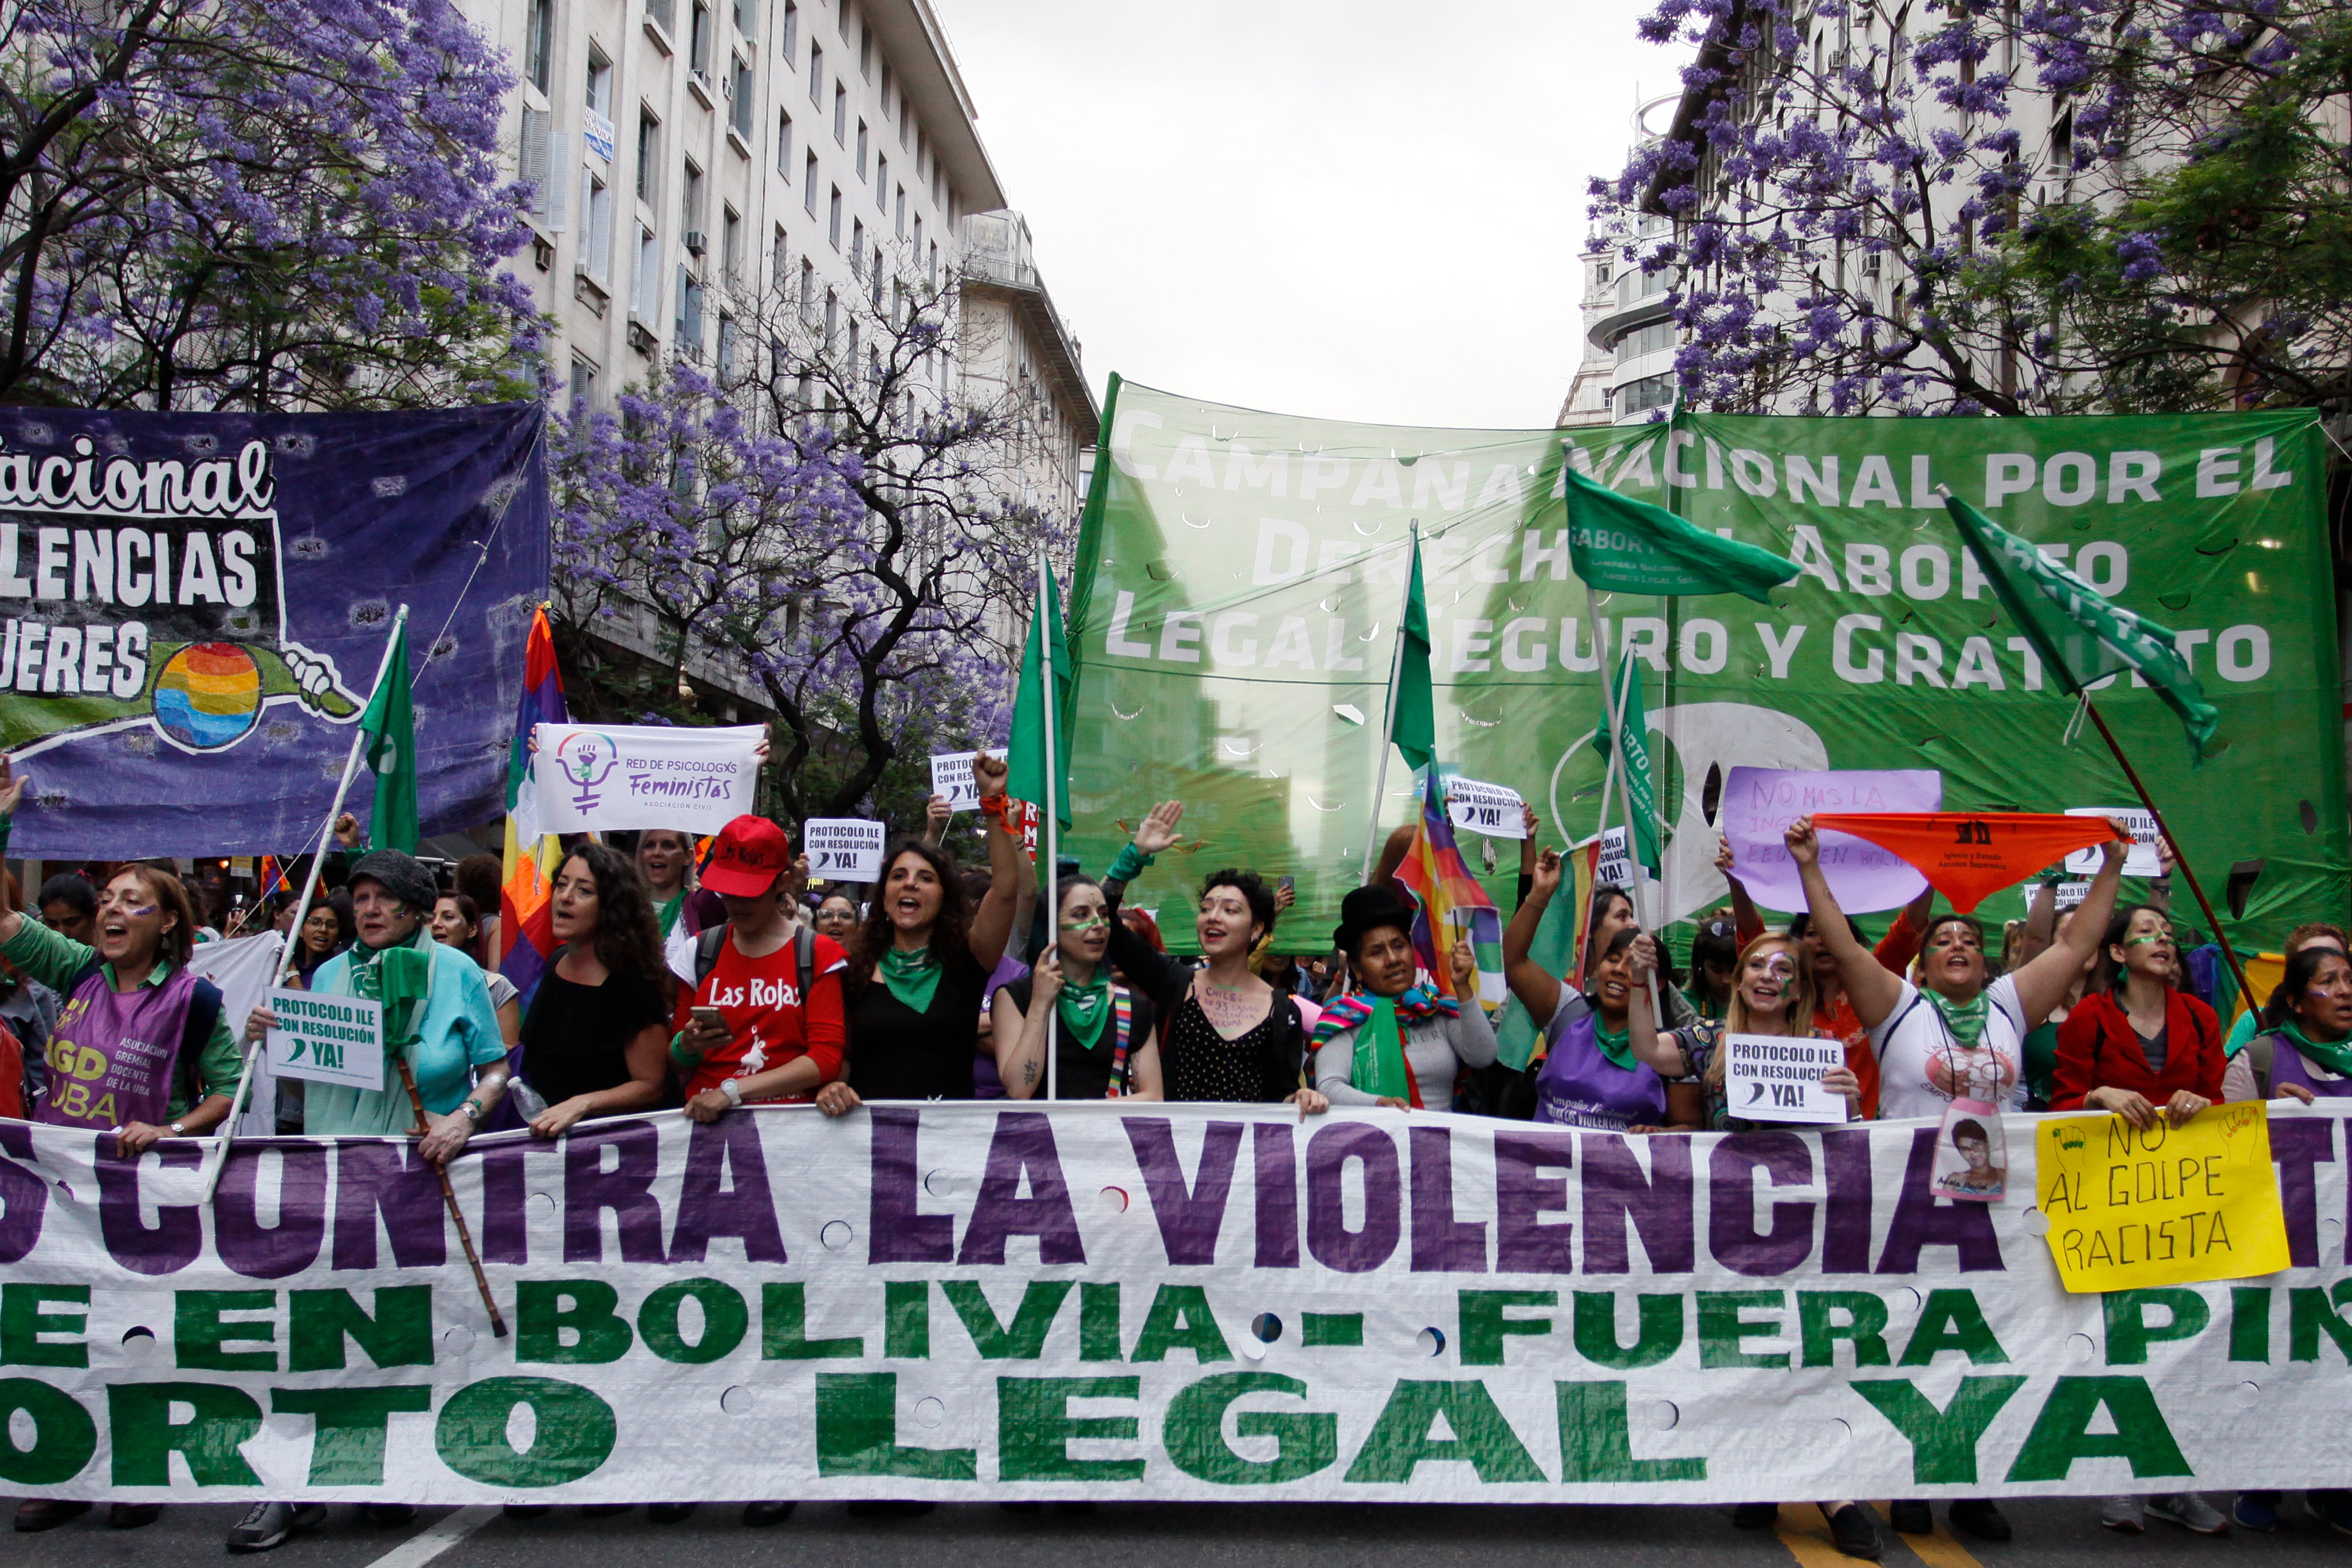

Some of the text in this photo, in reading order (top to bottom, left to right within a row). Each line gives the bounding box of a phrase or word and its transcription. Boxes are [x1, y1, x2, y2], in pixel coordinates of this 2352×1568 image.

[1550, 430, 1949, 508] NACIONAL
[1985, 451, 2162, 508] POR
[2195, 436, 2291, 498] EL
[1251, 517, 1568, 585] DERECH
[0, 523, 257, 607] LENCIAS
[1105, 590, 1364, 672] LEGAL
[1754, 622, 1807, 679] Y
[1833, 613, 2270, 691] GRATUTO
[626, 759, 646, 769] RED
[650, 760, 663, 770] DE
[937, 758, 975, 772] PROTO
[629, 773, 733, 800] Feministas
[938, 774, 956, 784] CON
[1451, 780, 1502, 796] PROTOCOLO
[643, 801, 690, 809] ASOCIACIÓN
[1453, 793, 1471, 803] CON
[1751, 780, 1887, 811] NO MAS LA
[1479, 807, 1501, 826] YA!
[2139, 817, 2155, 830] ILE
[810, 826, 879, 838] PROTOCOLO ILE
[809, 840, 879, 850] CON RESOLUCIÓN
[834, 852, 858, 869] YA!
[1819, 846, 1849, 865] EN
[1944, 852, 1968, 860] Iglesia
[1977, 852, 2002, 860] Estado
[1970, 861, 2008, 870] Separados
[1599, 863, 1624, 882] YA!
[708, 977, 744, 1007] Las
[272, 997, 375, 1026] PROTOCOLO ILE
[274, 1017, 375, 1045] CON RESOLUCIÓN
[115, 1050, 151, 1069] GREMIAL
[311, 1040, 344, 1070] YA!
[1733, 1044, 1838, 1064] PROTOCOLO ILE
[111, 1063, 150, 1083] DOCENTE
[1733, 1063, 1829, 1082] CON RESOLUCIÓ
[106, 1076, 151, 1097] DE LA UBA
[1770, 1083, 1805, 1108] YA!
[2108, 1117, 2166, 1158] NO
[94, 1110, 788, 1279] CONTRA
[869, 1107, 1087, 1266] LA
[1121, 1117, 2007, 1276] VIOLENCIA
[2044, 1155, 2225, 1213] AL GOLPE
[2062, 1210, 2233, 1272] RACISTA
[1, 1283, 91, 1368] E
[175, 1284, 435, 1372] EN
[516, 1277, 1235, 1366] BOLIVIA
[1458, 1288, 2011, 1370] FUERA
[0, 1371, 2196, 1488] ORTO LEGAL YA
